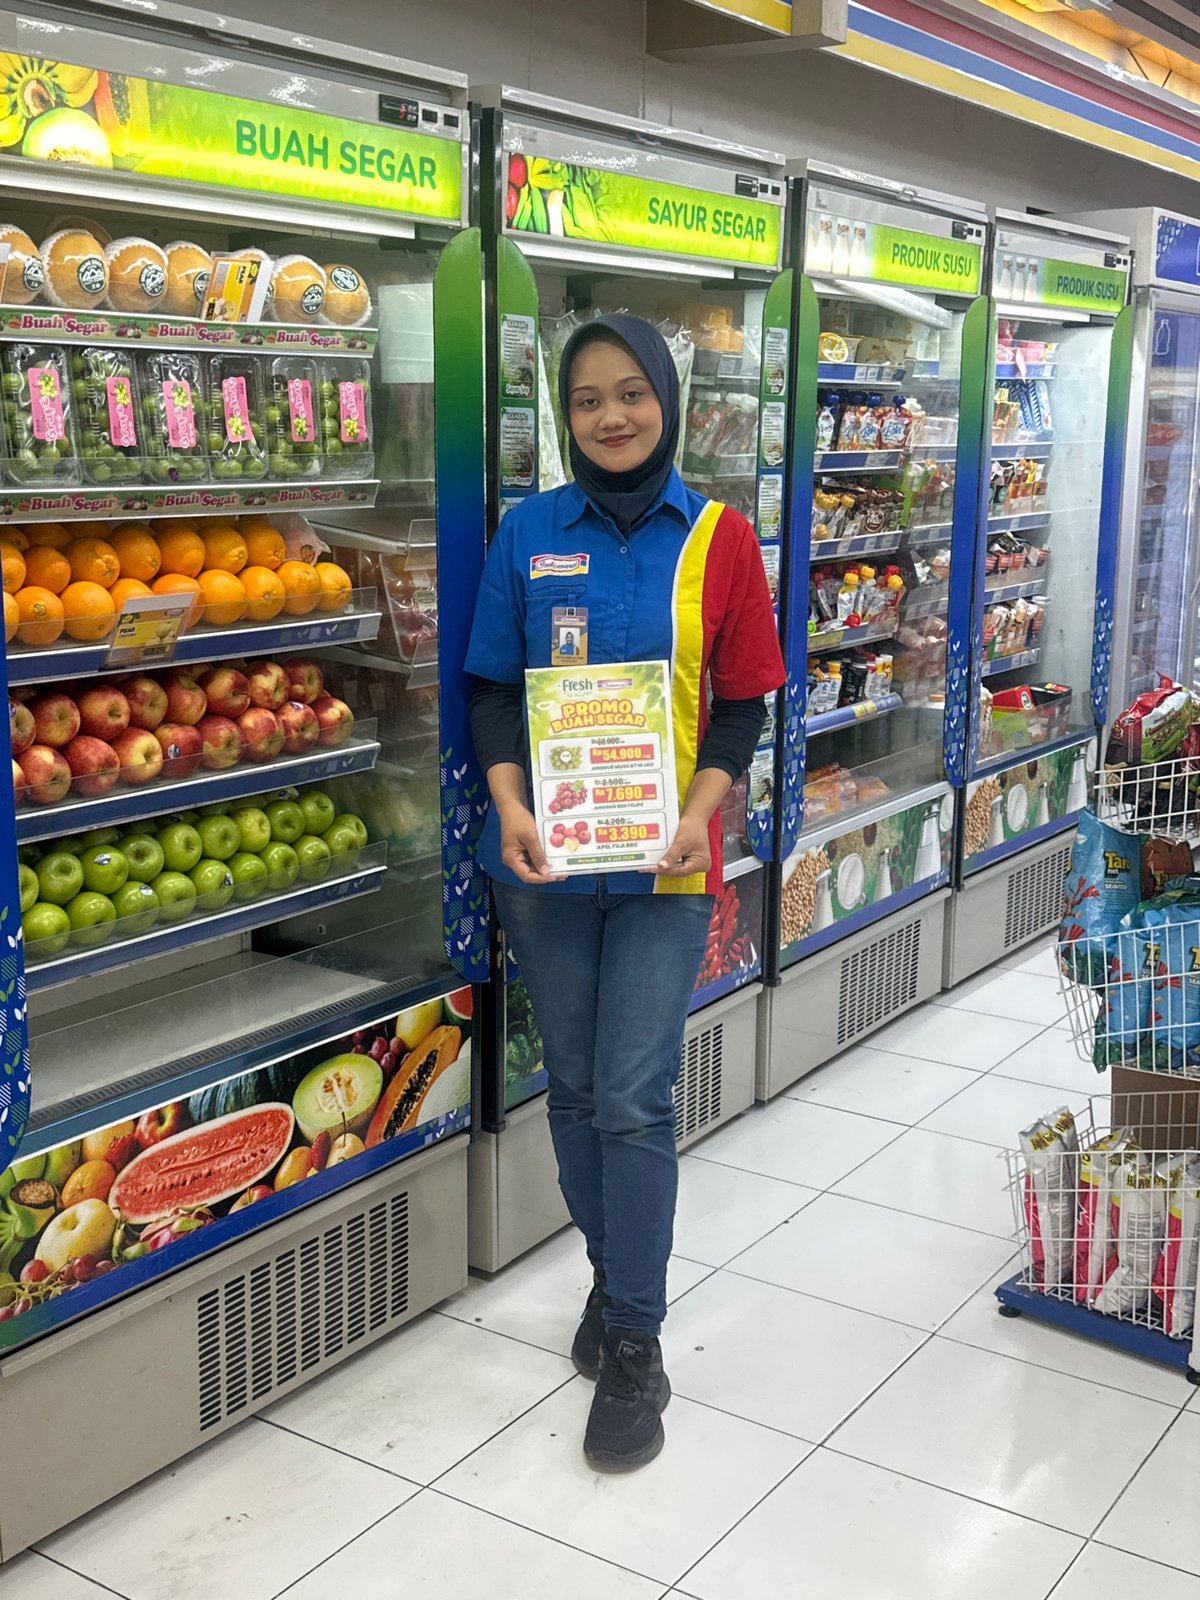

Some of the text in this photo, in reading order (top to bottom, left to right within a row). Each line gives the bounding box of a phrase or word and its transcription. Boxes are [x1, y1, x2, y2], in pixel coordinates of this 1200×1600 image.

[236, 119, 436, 190] BUAH SEGAR
[648, 197, 766, 242] SAYUR SEGAR
[892, 242, 972, 277] PRODUK SUSU
[1057, 275, 1119, 300] PRODUK SUSU
[22, 315, 107, 335] Buah Segar
[159, 324, 235, 343] Buah Segar
[277, 331, 342, 346] Buah Segar
[31, 497, 115, 511] Buah Segar
[165, 494, 238, 507] Buah Segar
[280, 490, 345, 502] Buah Segar
[563, 678, 592, 691] Fresh
[562, 699, 633, 718] PROMO
[551, 713, 646, 733] BUAH SEGAR
[606, 786, 642, 801] 7.690
[609, 825, 647, 841] 3.390
